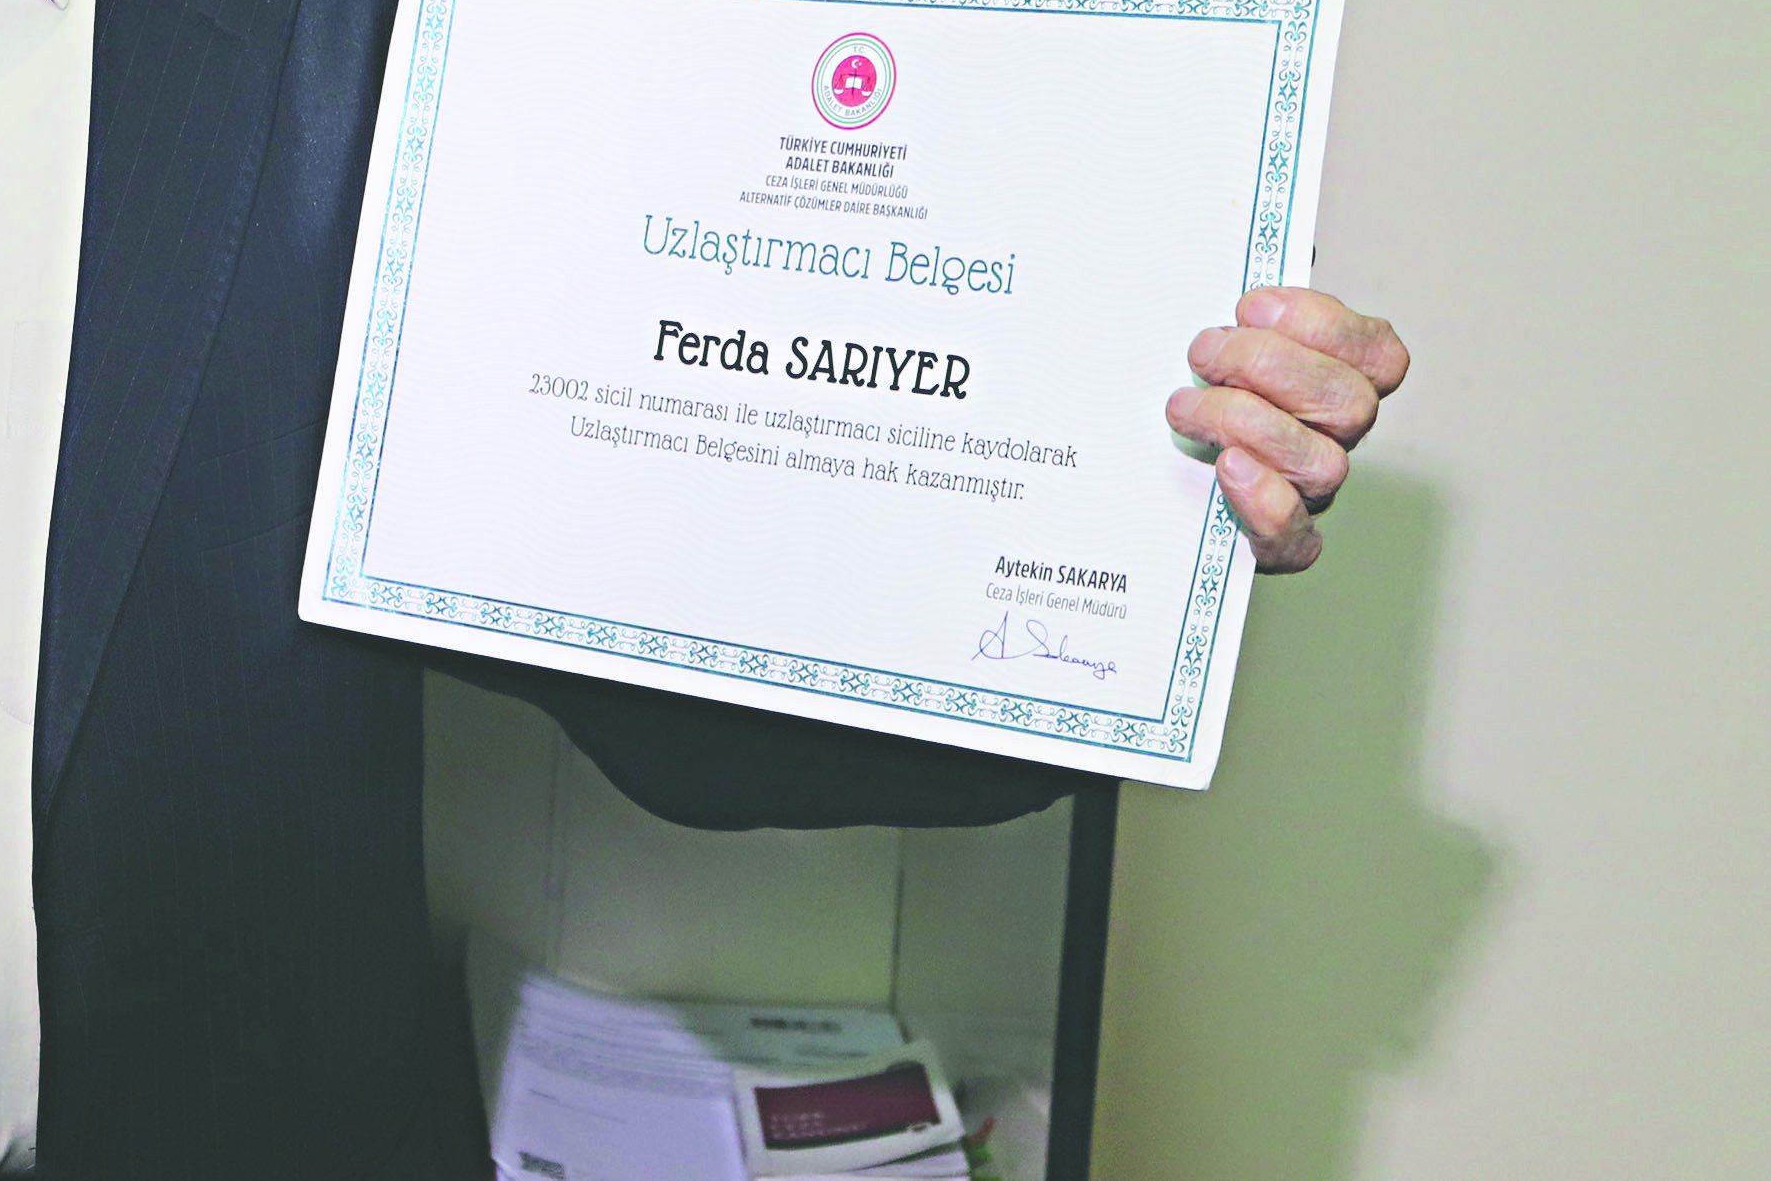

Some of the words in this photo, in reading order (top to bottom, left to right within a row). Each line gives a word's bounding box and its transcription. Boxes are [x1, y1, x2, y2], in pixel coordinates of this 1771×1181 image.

[823, 85, 842, 112] ADALET
[845, 88, 883, 116] BAKANLIĞI
[780, 136, 828, 154] TÜRKİYE
[830, 140, 907, 161] CUMHURİYETİ
[786, 156, 829, 173] ADALET
[832, 160, 894, 178] BAKANLIĞI
[739, 191, 792, 207] ALTERNATİF
[794, 195, 841, 212] ÇÖZÜMLER
[844, 200, 870, 215] DAİRE
[873, 203, 928, 220] BAŞKANLIĞI
[765, 175, 788, 187] CEZA
[790, 175, 818, 191] İŞLERİ
[821, 181, 848, 193] GENEL
[851, 183, 908, 199] MÜDÜRLÜĞÜ
[642, 215, 872, 281] Uzlaştırmacı
[886, 241, 1017, 296] Belgesi
[653, 320, 770, 377] Ferda
[786, 337, 972, 401] SARIYER
[528, 373, 588, 401] 23002
[595, 383, 632, 408] sicil
[639, 392, 728, 421] numarası
[735, 403, 758, 425] ile
[765, 409, 881, 442] uzlaştırmacı
[888, 423, 956, 452] siciline
[961, 431, 1078, 467] kaydolarak
[570, 415, 688, 453] Uzlaştırmacı
[696, 434, 779, 467] Belgesini
[785, 448, 856, 478] almaya
[862, 457, 898, 483] hak
[906, 463, 1024, 501] kazanmıştır.
[995, 556, 1053, 582] Aytekin
[1056, 565, 1127, 593] SAKARYA
[986, 582, 1012, 601] Ceza
[1016, 585, 1044, 605] İşleri
[1047, 592, 1079, 611] Genel
[1082, 598, 1127, 619] Müdürü
